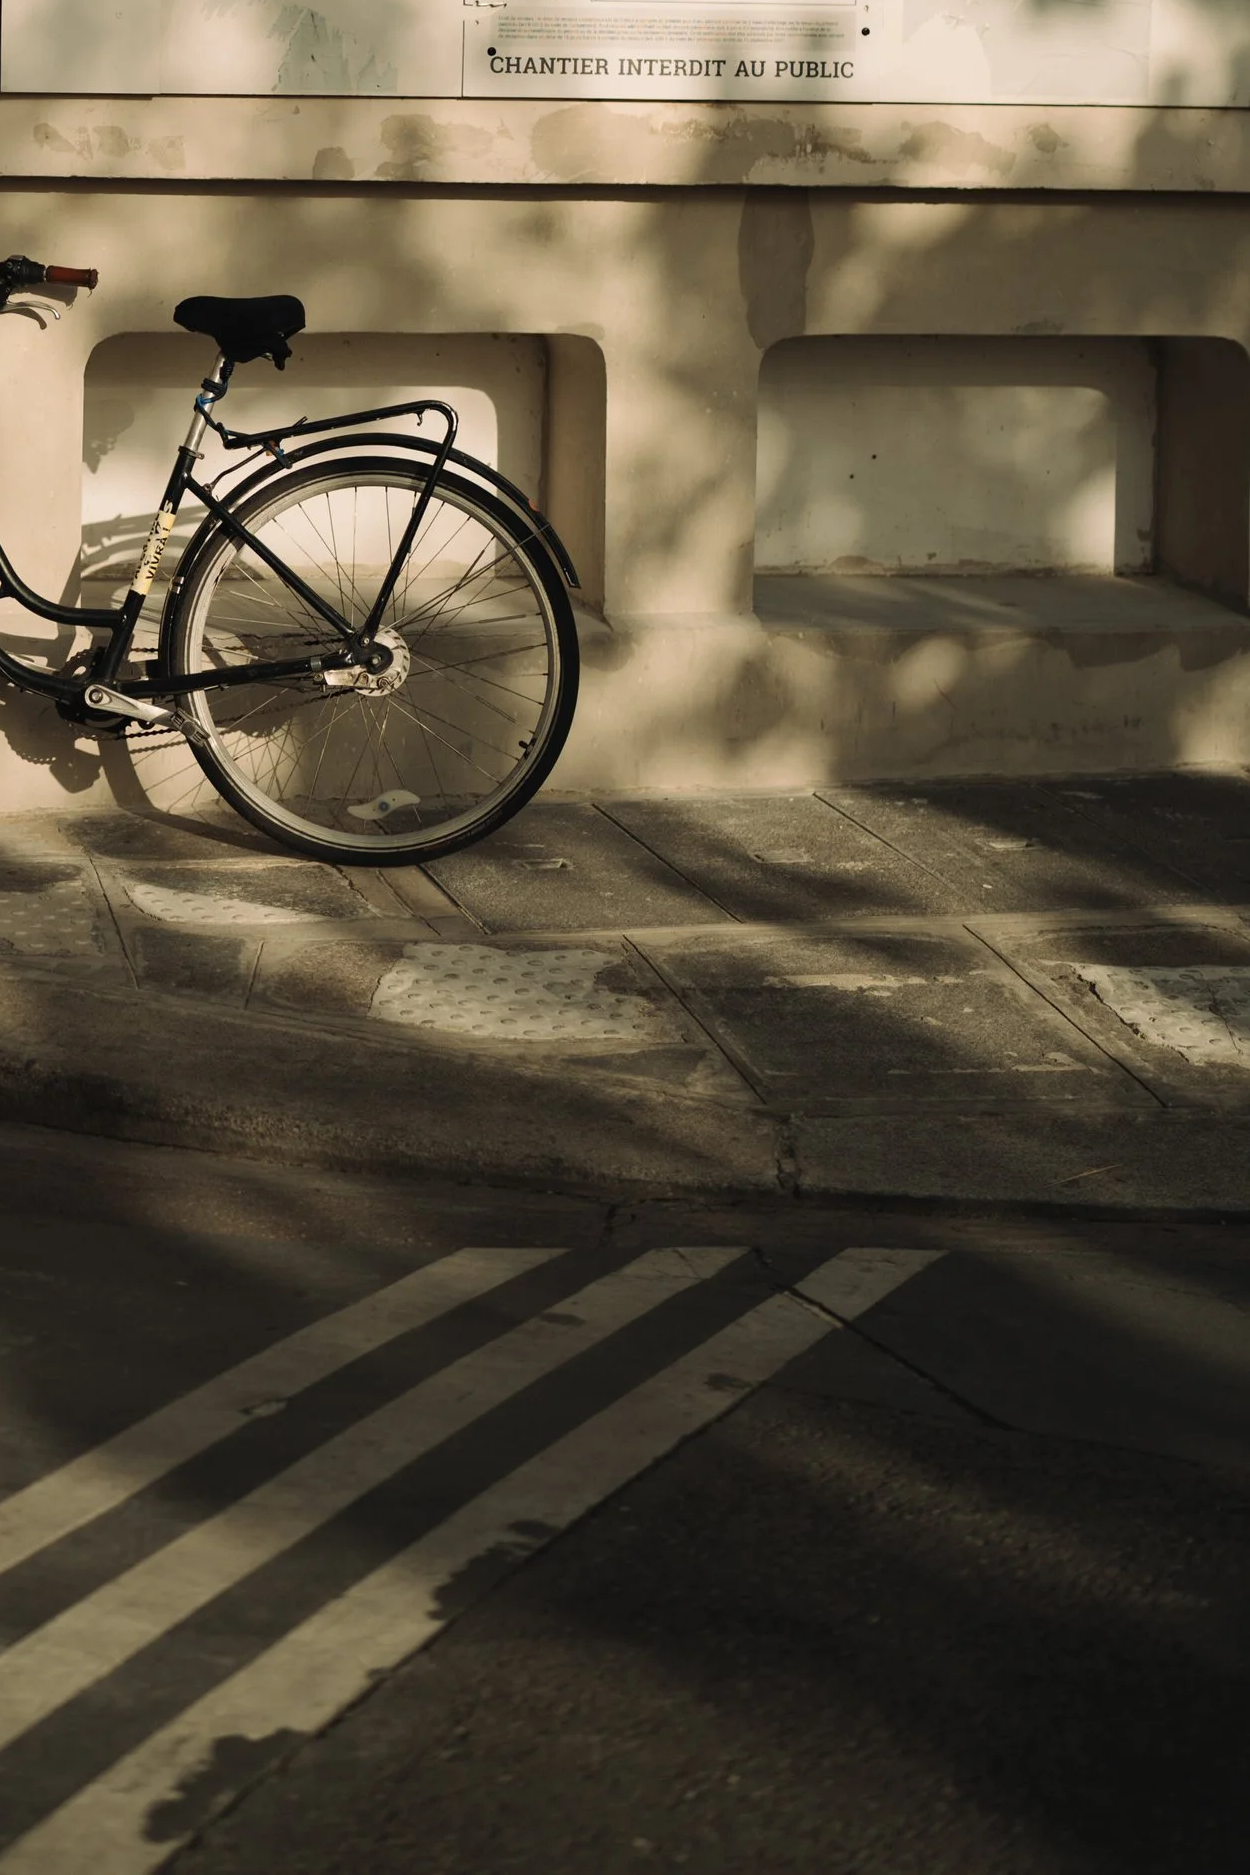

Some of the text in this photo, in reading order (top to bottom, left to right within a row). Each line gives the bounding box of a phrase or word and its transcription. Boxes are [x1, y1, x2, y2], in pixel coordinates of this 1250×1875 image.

[490, 56, 855, 80] CHANTIER INTERDIT AU PUBLIC
